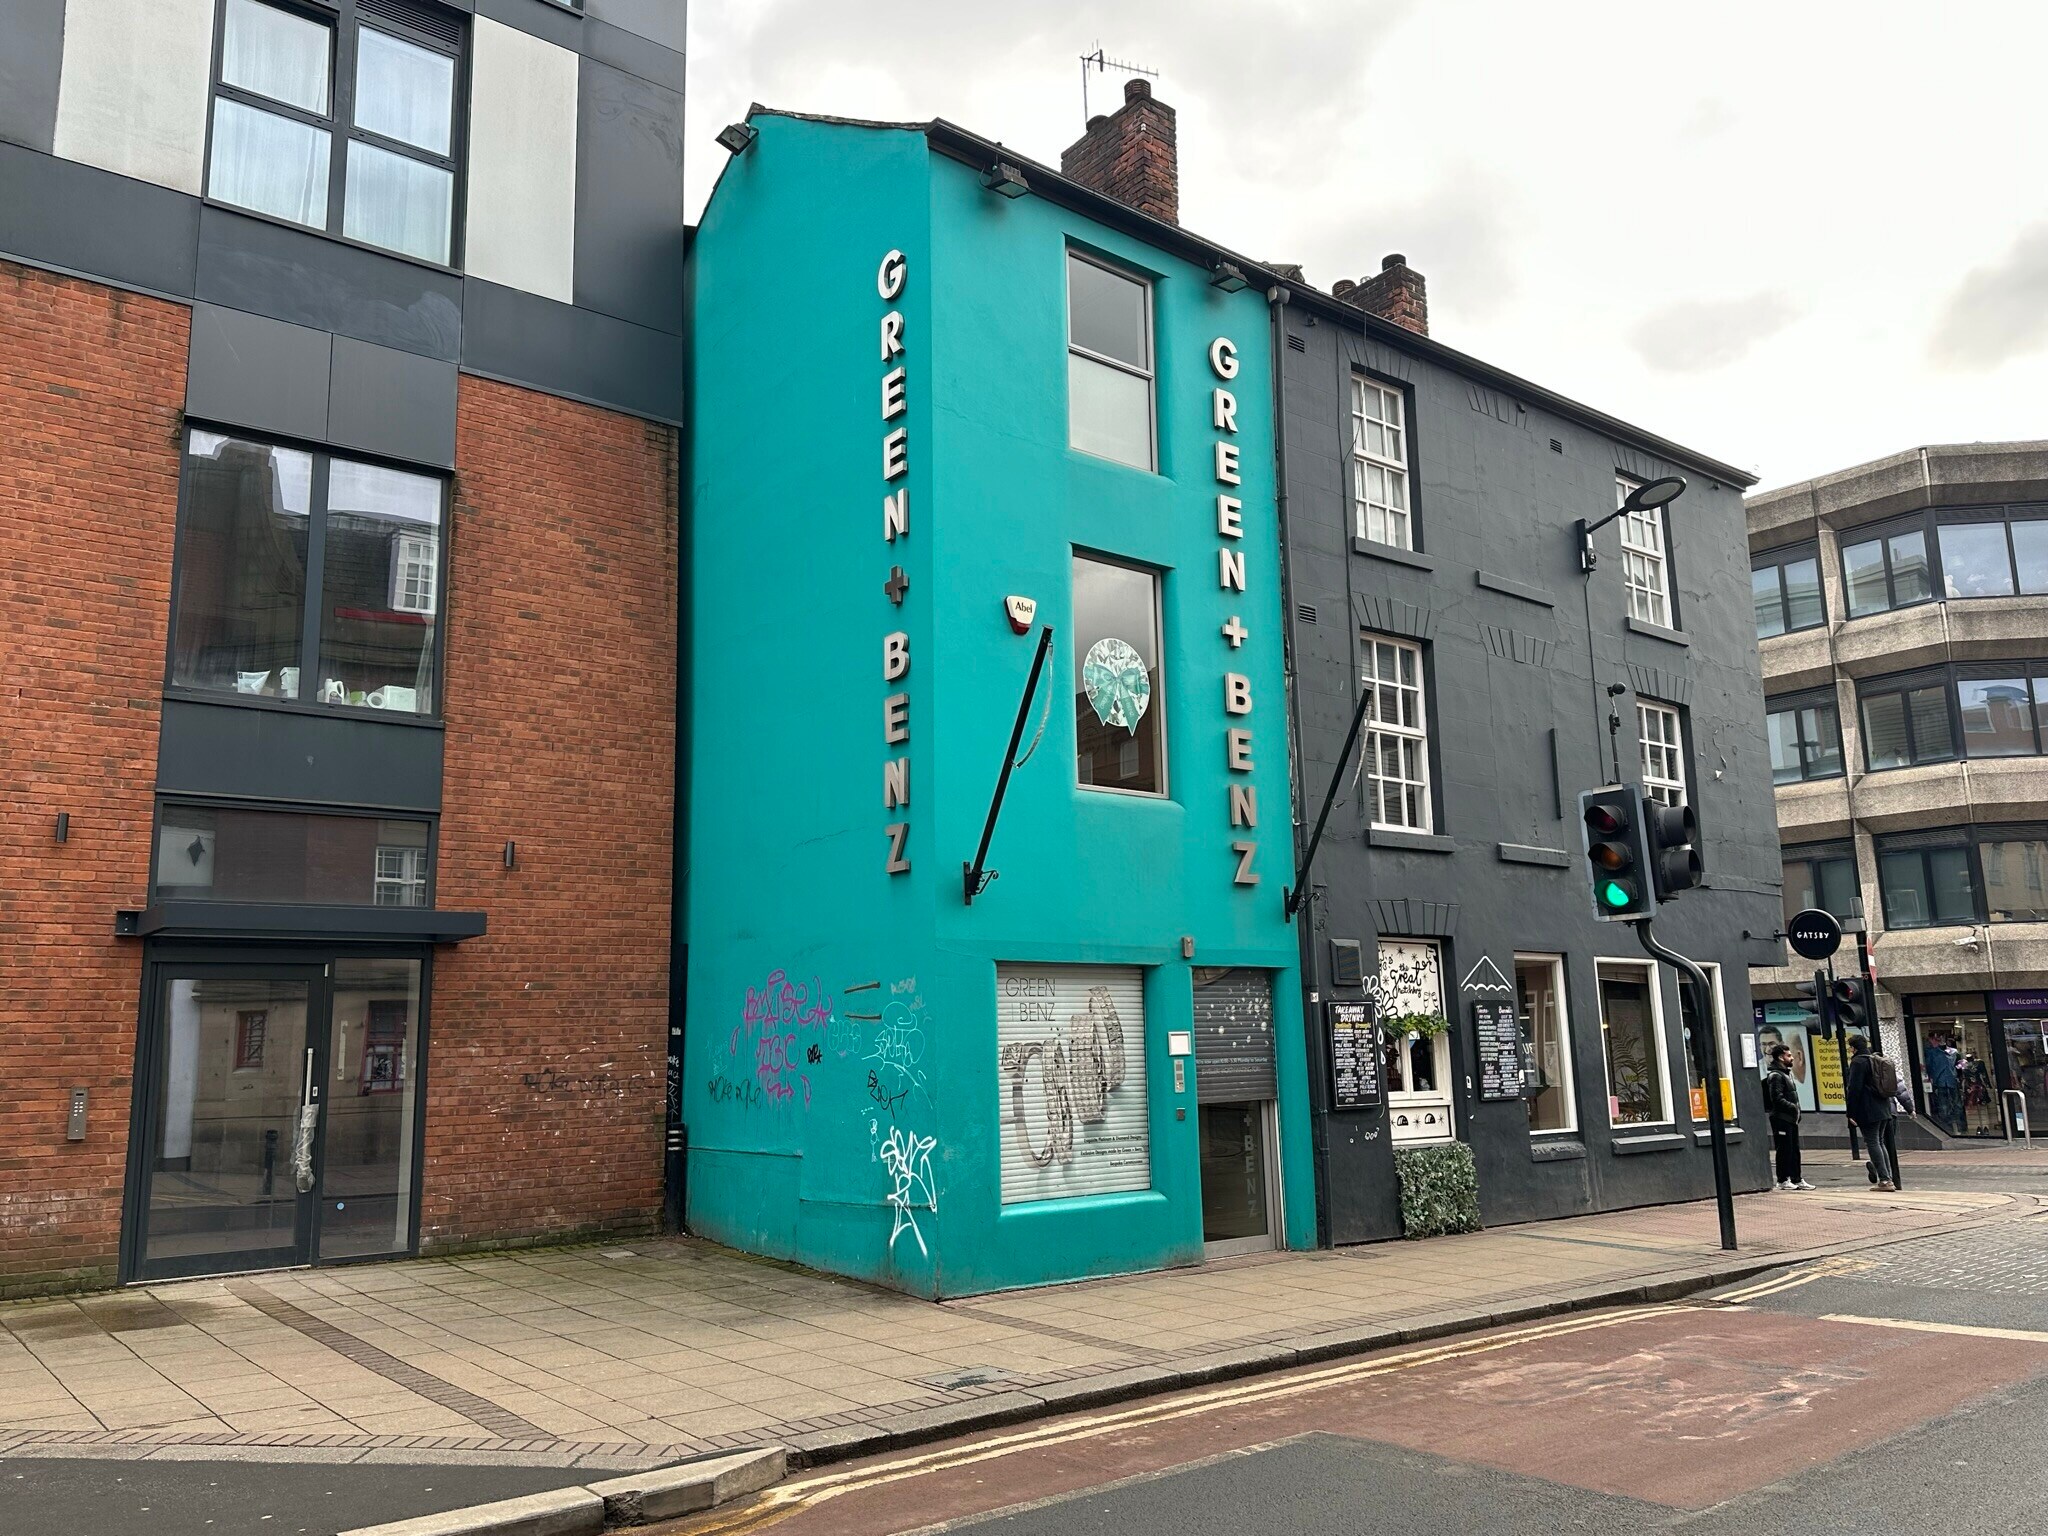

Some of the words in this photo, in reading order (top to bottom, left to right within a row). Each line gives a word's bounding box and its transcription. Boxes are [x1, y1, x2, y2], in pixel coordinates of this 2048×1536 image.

[877, 249, 909, 543] GREEN
[1209, 336, 1245, 592] GREEN
[1015, 601, 1033, 613] Abel
[883, 631, 911, 874] BENZ
[1225, 672, 1260, 884] BENZ
[1796, 931, 1830, 939] GATSBY
[1005, 977, 1056, 997] GREEN
[1334, 1004, 1365, 1014] TAKEAWAY
[1340, 1013, 1365, 1023] DRINKS
